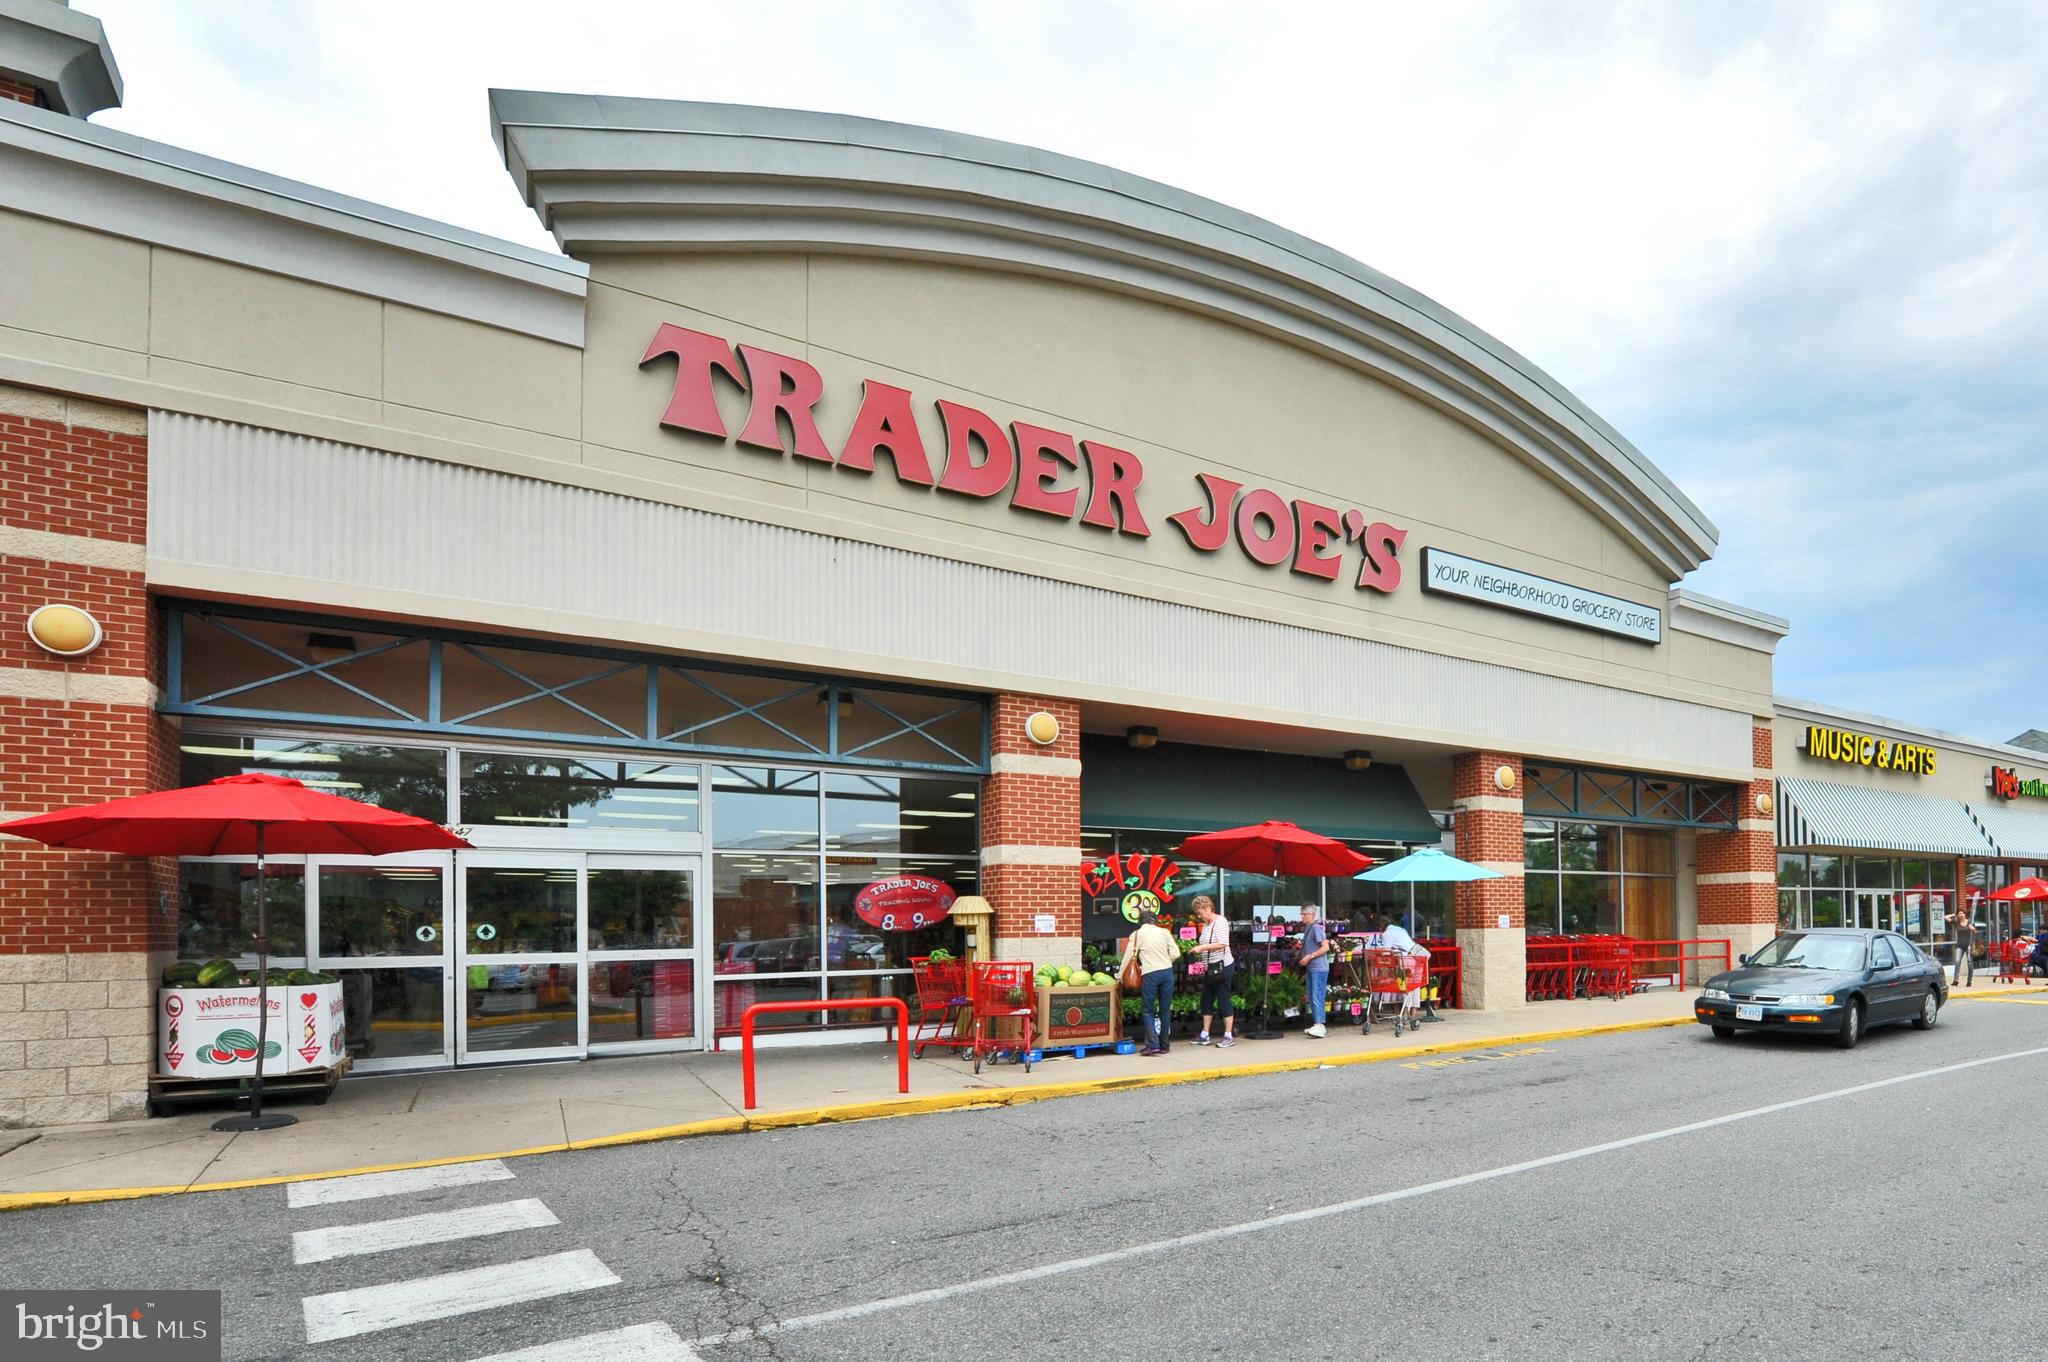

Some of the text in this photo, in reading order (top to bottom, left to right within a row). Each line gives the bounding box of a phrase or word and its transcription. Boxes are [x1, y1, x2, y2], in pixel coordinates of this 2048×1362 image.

[638, 321, 1408, 594] TRADER JOE'S
[1434, 563, 1656, 631] YOUR NEIGHBORHOOD GROCERY STORE
[1809, 726, 1937, 775] MUSIC & ARTS
[870, 879, 938, 896] TRADER JOE'S
[1080, 853, 1181, 904] BASIL
[878, 898, 911, 907] TRADING
[197, 994, 281, 1013] Watermelns
[1071, 1027, 1106, 1035] Watermelon
